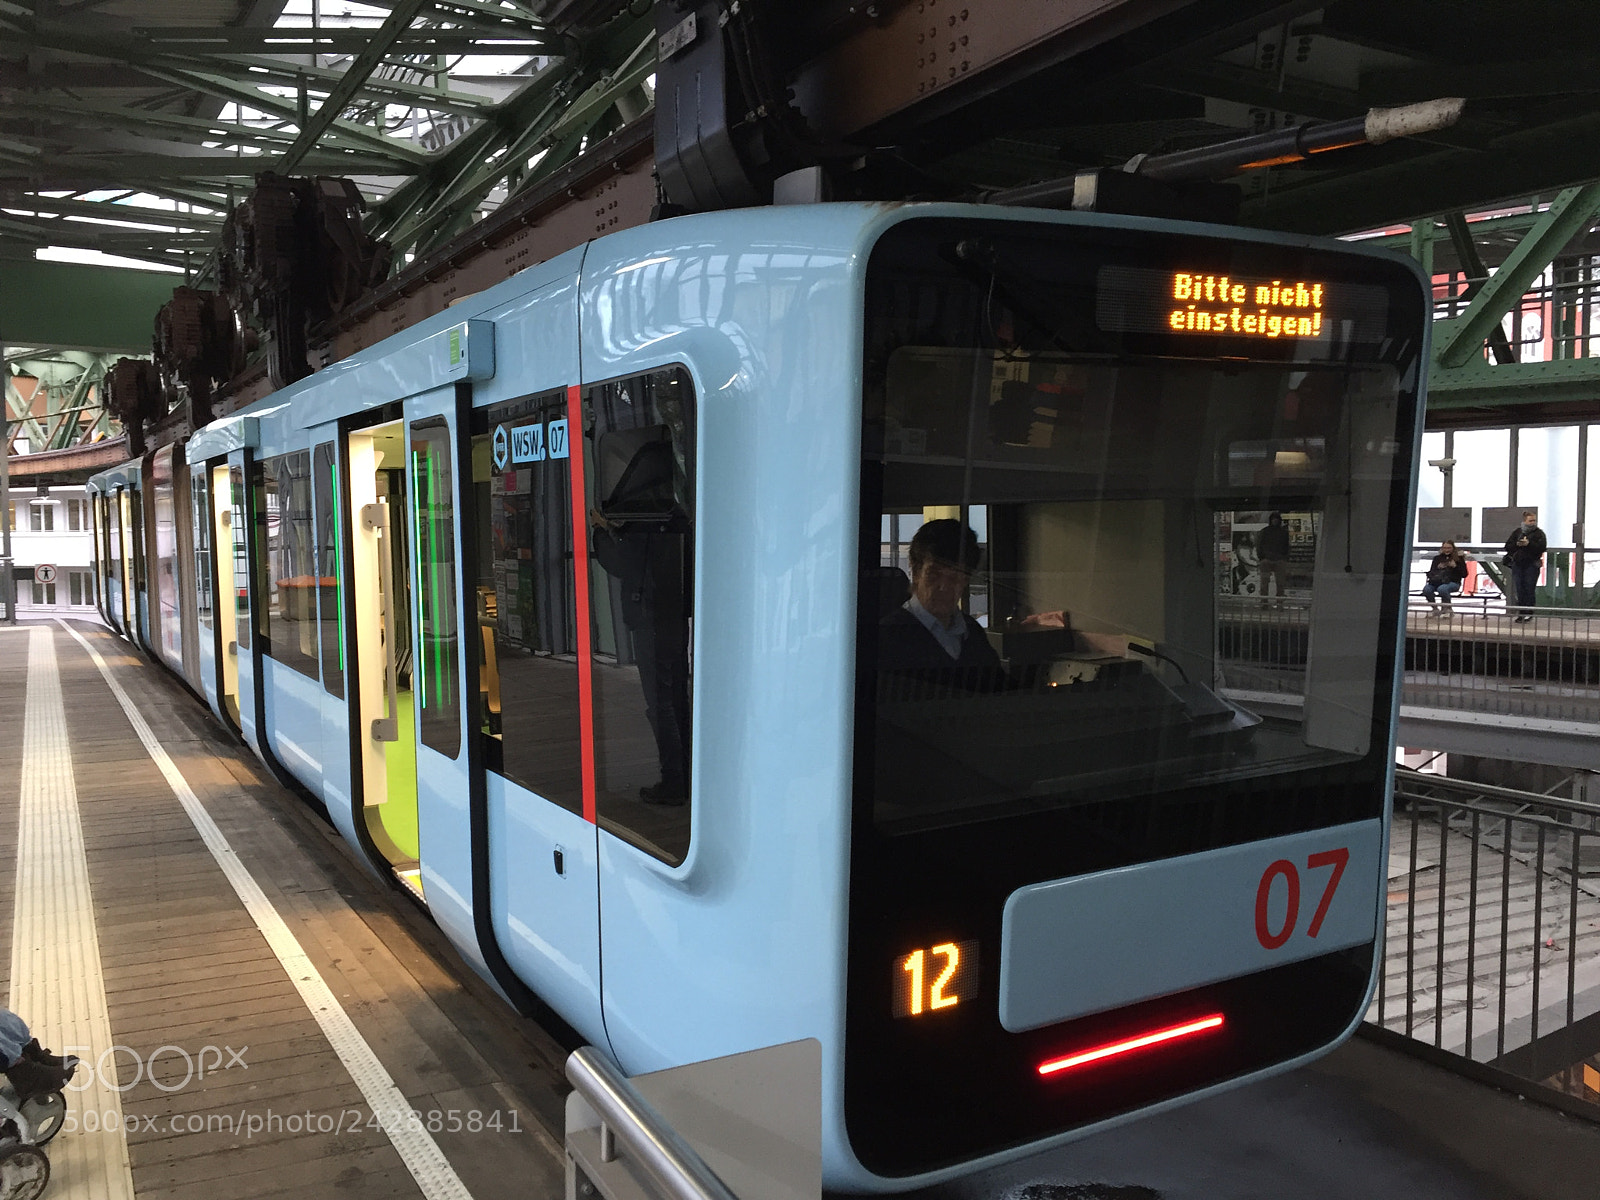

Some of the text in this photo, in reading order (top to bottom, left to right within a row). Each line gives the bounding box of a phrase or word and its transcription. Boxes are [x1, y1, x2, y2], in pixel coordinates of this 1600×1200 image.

[1173, 273, 1323, 308] Bitte nicht
[1169, 305, 1322, 338] einsteigen!
[550, 425, 565, 453] 07
[1254, 847, 1350, 950] 07
[903, 942, 960, 1016] 12
